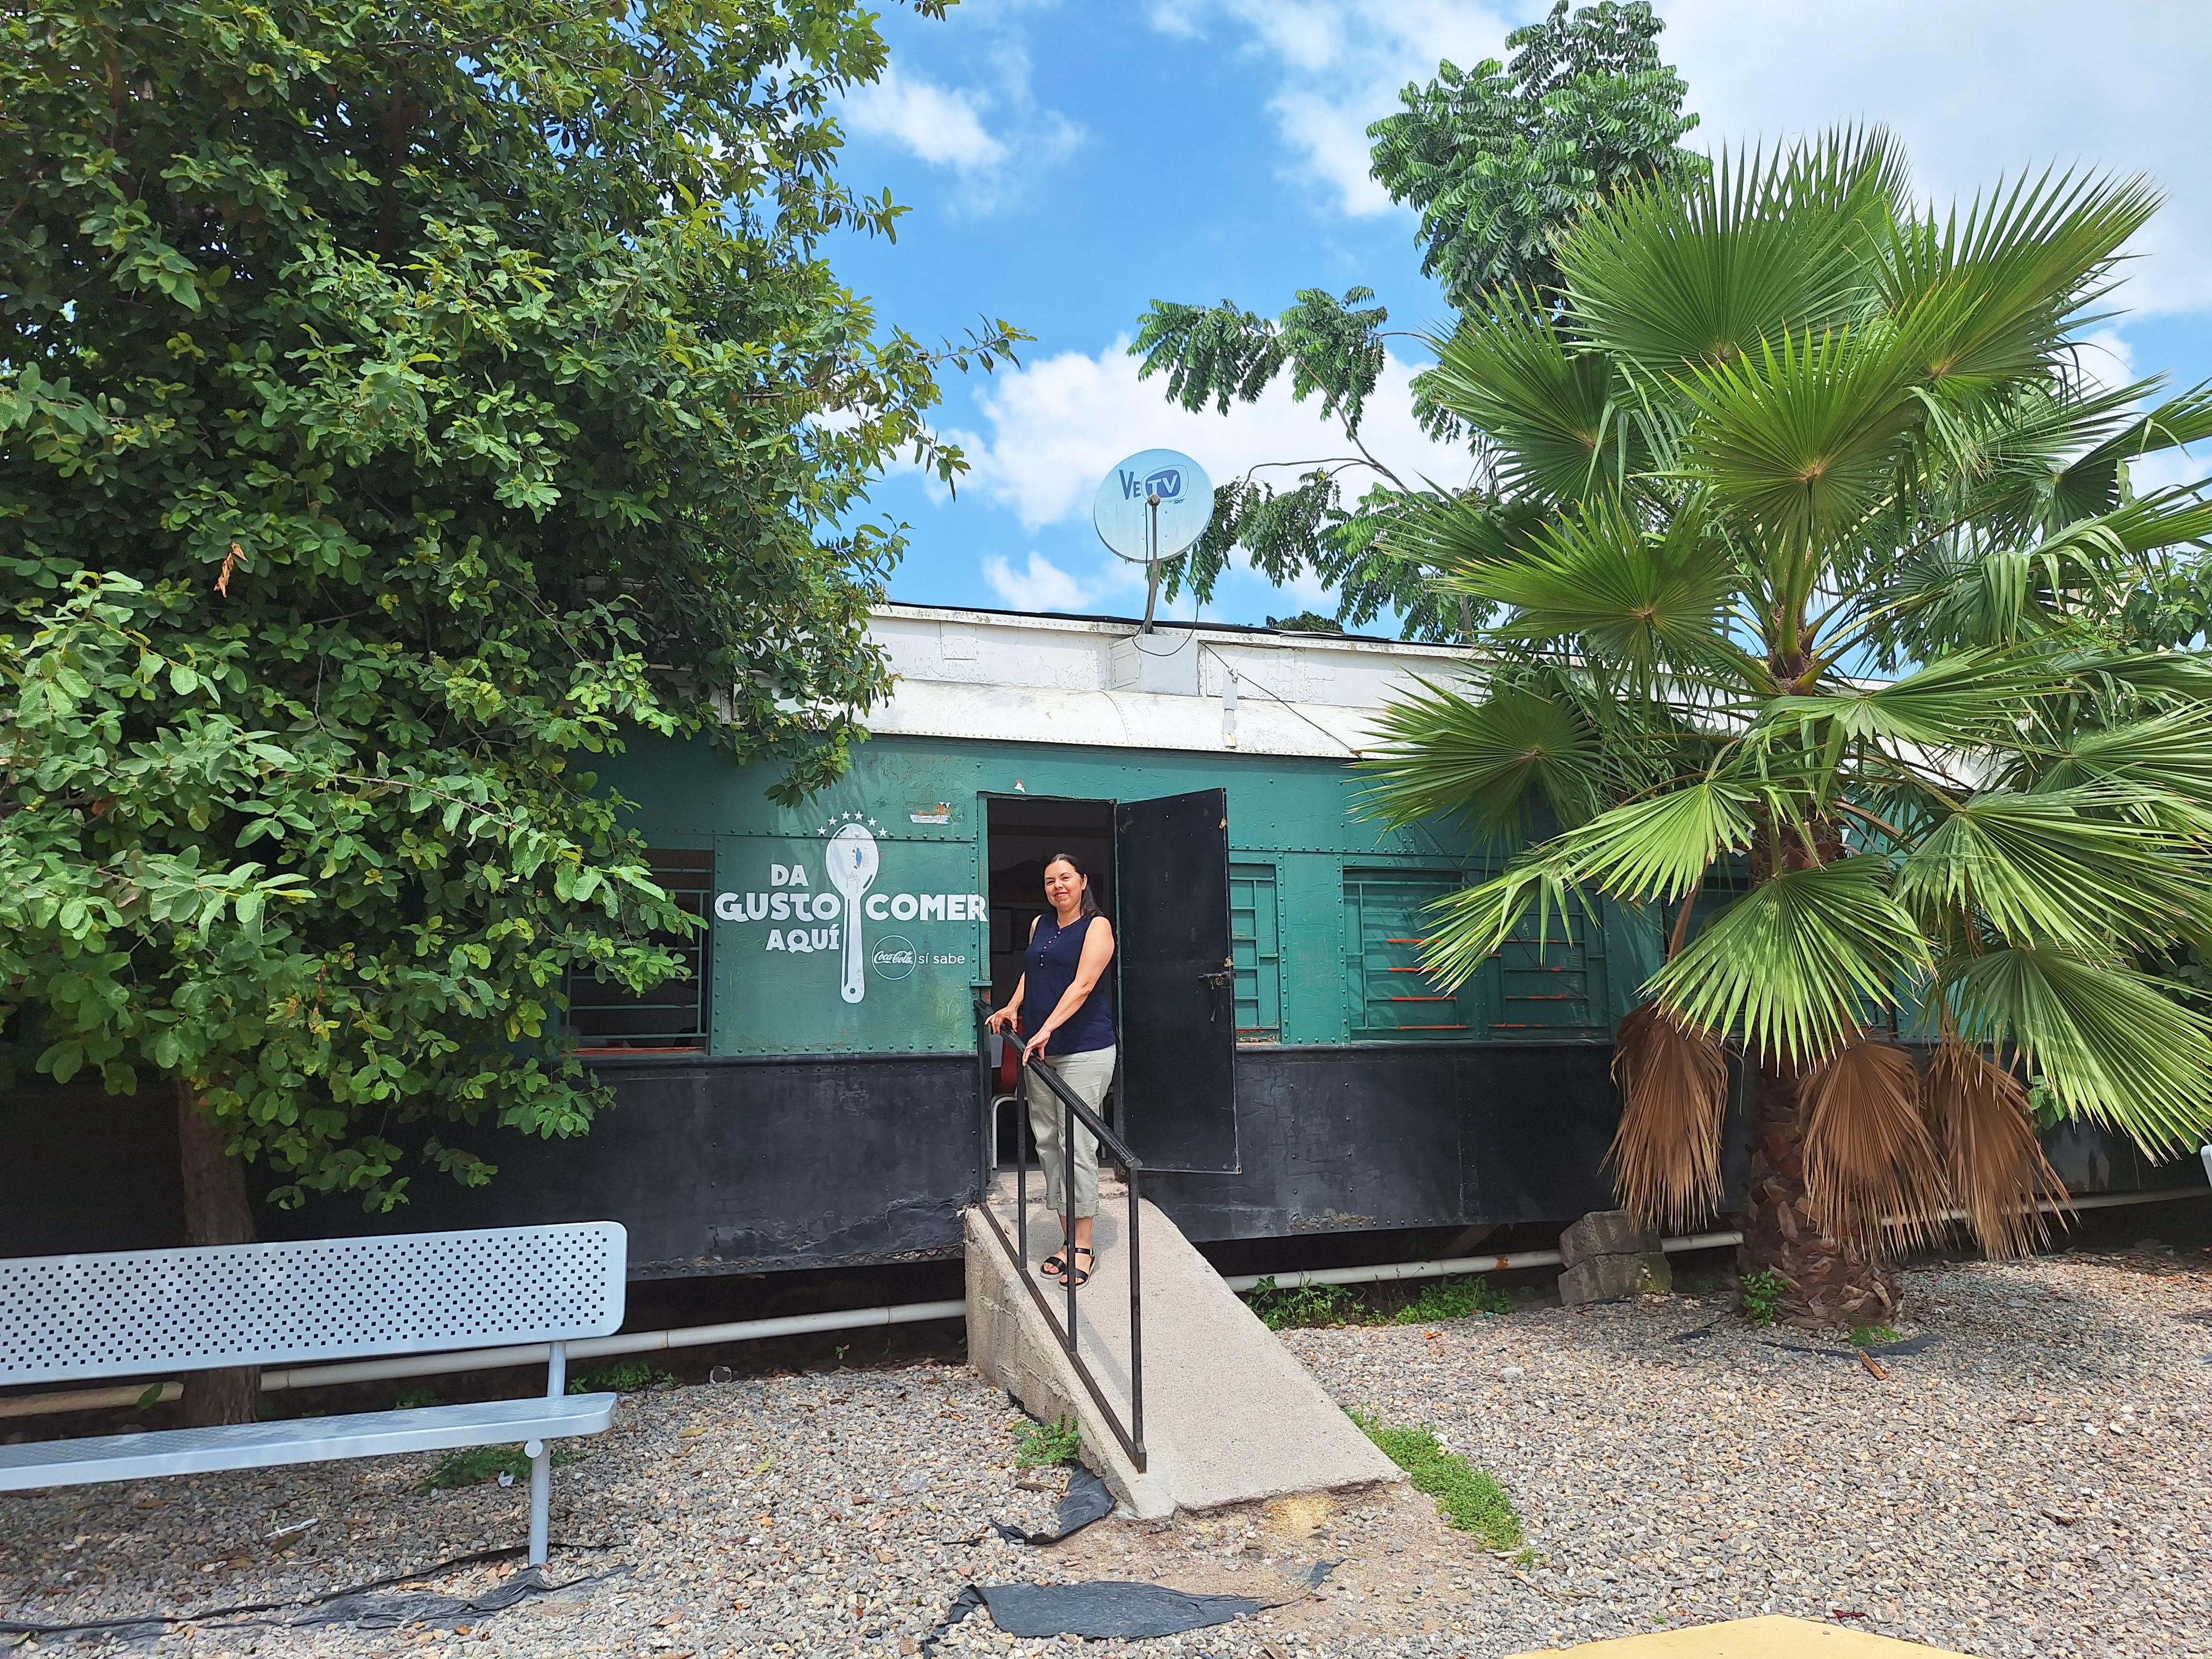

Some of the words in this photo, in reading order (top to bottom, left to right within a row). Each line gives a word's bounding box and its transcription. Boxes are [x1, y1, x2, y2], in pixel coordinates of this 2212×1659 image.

[770, 864, 809, 887] DA
[714, 892, 841, 922] GUSTO
[865, 893, 988, 922] COMER
[765, 923, 840, 954] AQUÍ
[918, 952, 930, 964] sí
[933, 953, 965, 964] sabe
